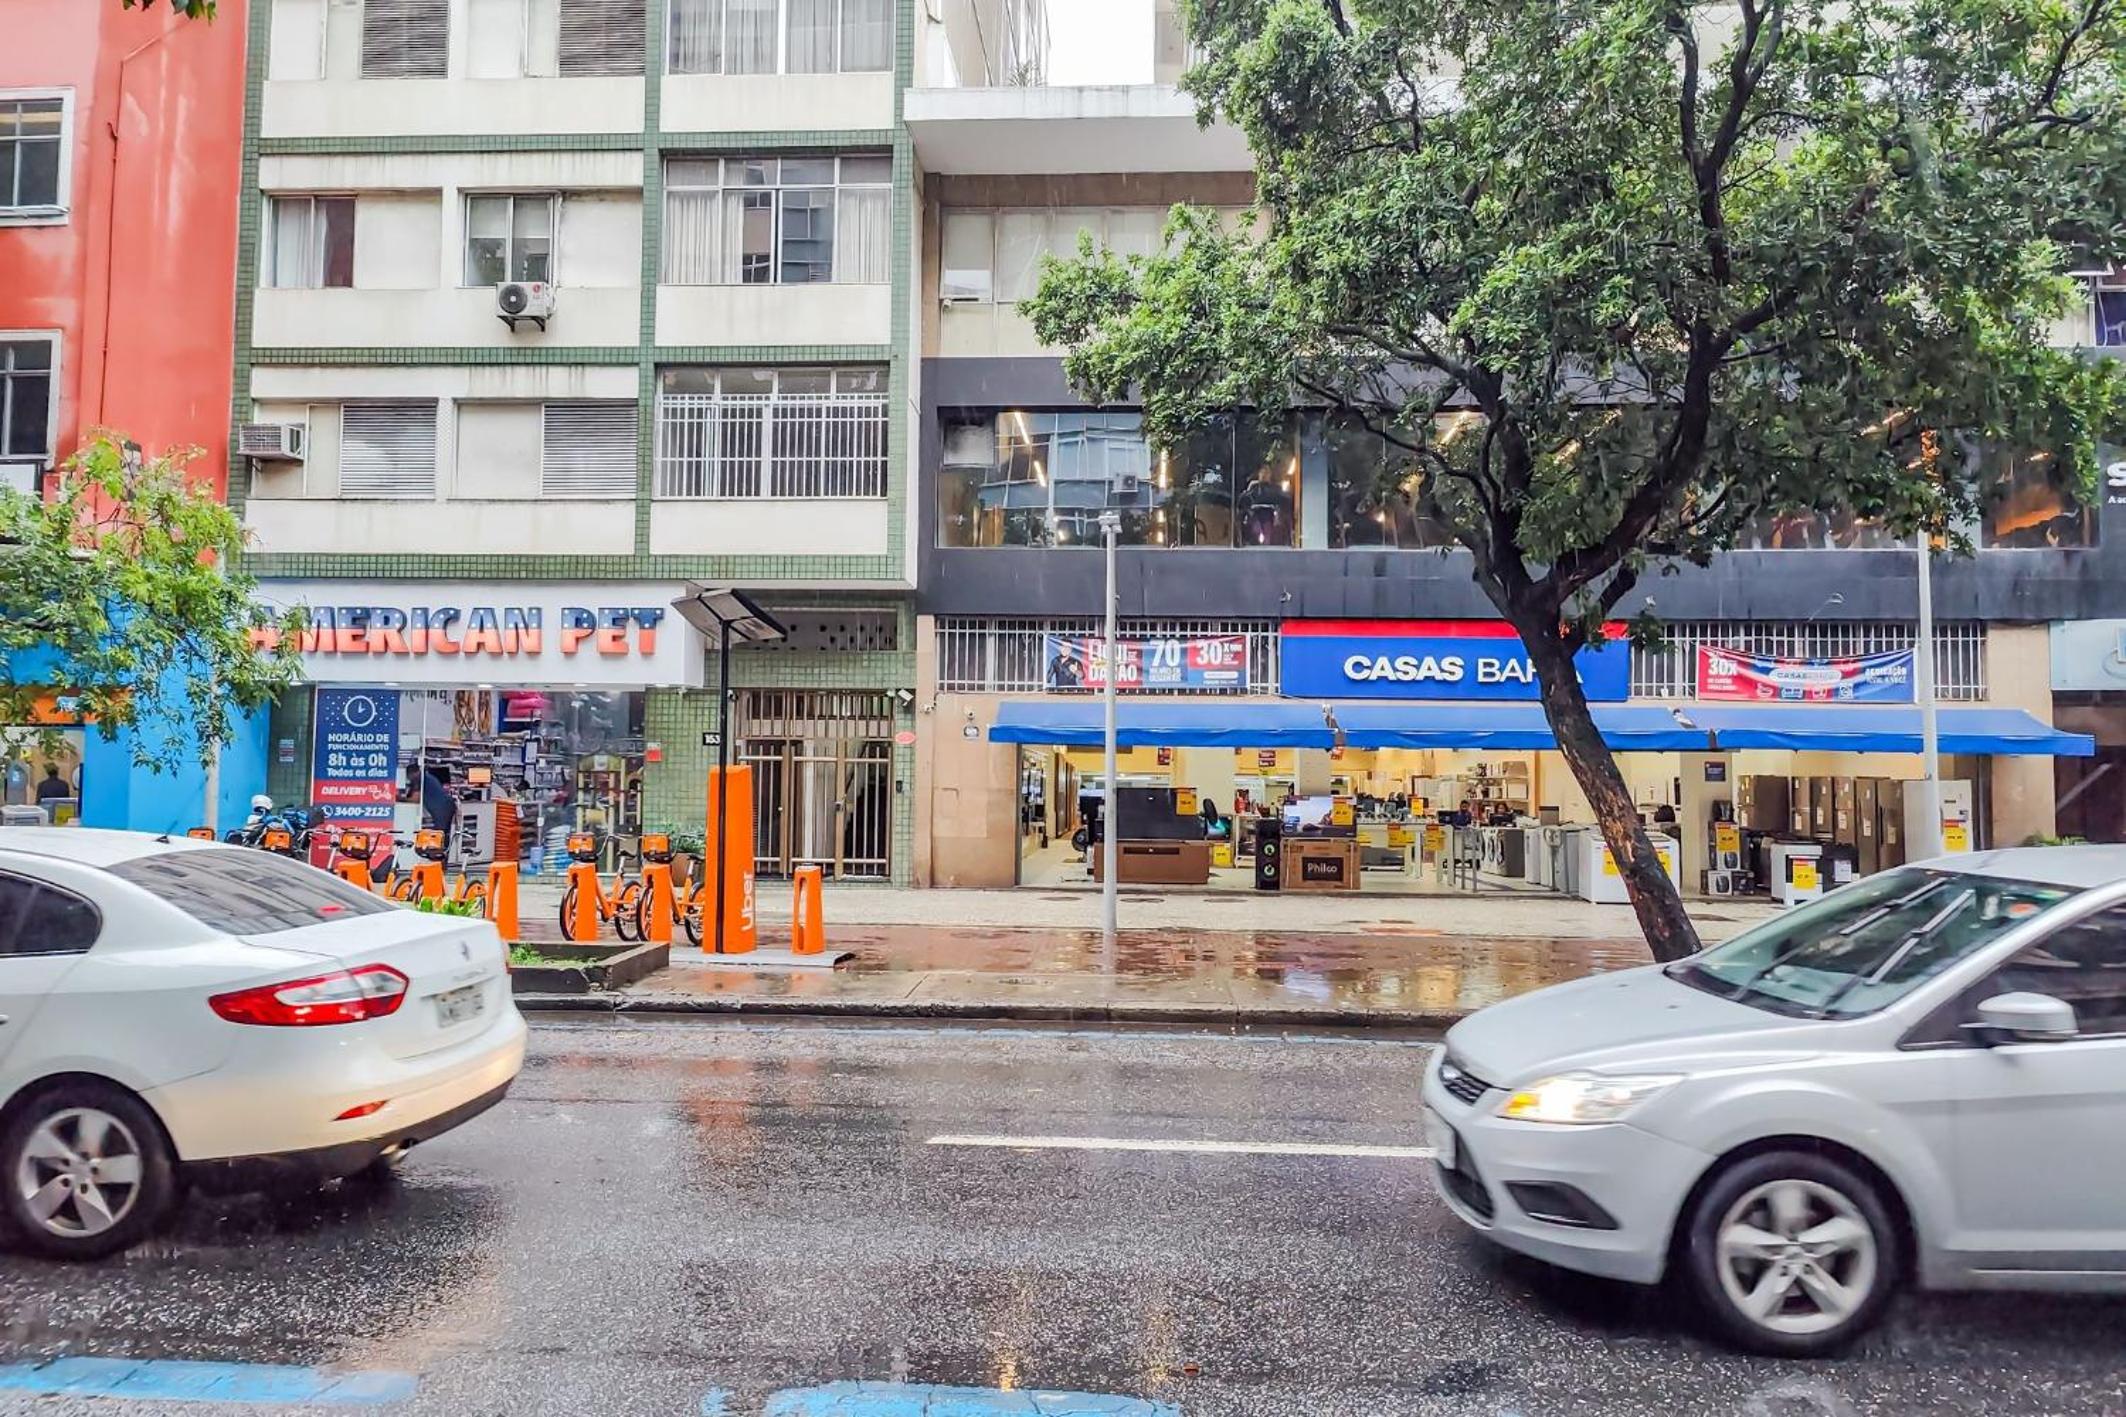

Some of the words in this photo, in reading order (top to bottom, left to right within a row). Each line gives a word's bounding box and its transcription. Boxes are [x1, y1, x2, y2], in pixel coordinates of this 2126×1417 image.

[247, 606, 542, 655] AMERICAN
[561, 607, 665, 655] PET
[1149, 639, 1180, 667] 70
[1344, 656, 1465, 682] CASAS
[328, 731, 374, 742] HORÁRIO
[376, 733, 390, 742] DE
[328, 743, 389, 751] FUNCIONAMENTO
[328, 752, 347, 767] 8h
[350, 752, 365, 766] às
[368, 753, 388, 767] 0h
[327, 767, 353, 777] Todos
[355, 769, 366, 777] os
[368, 767, 388, 777] dias
[321, 785, 367, 795] DELIVERY
[334, 806, 391, 816] 3400-2125
[1307, 863, 1338, 873] Philco
[741, 872, 753, 931] Uber
